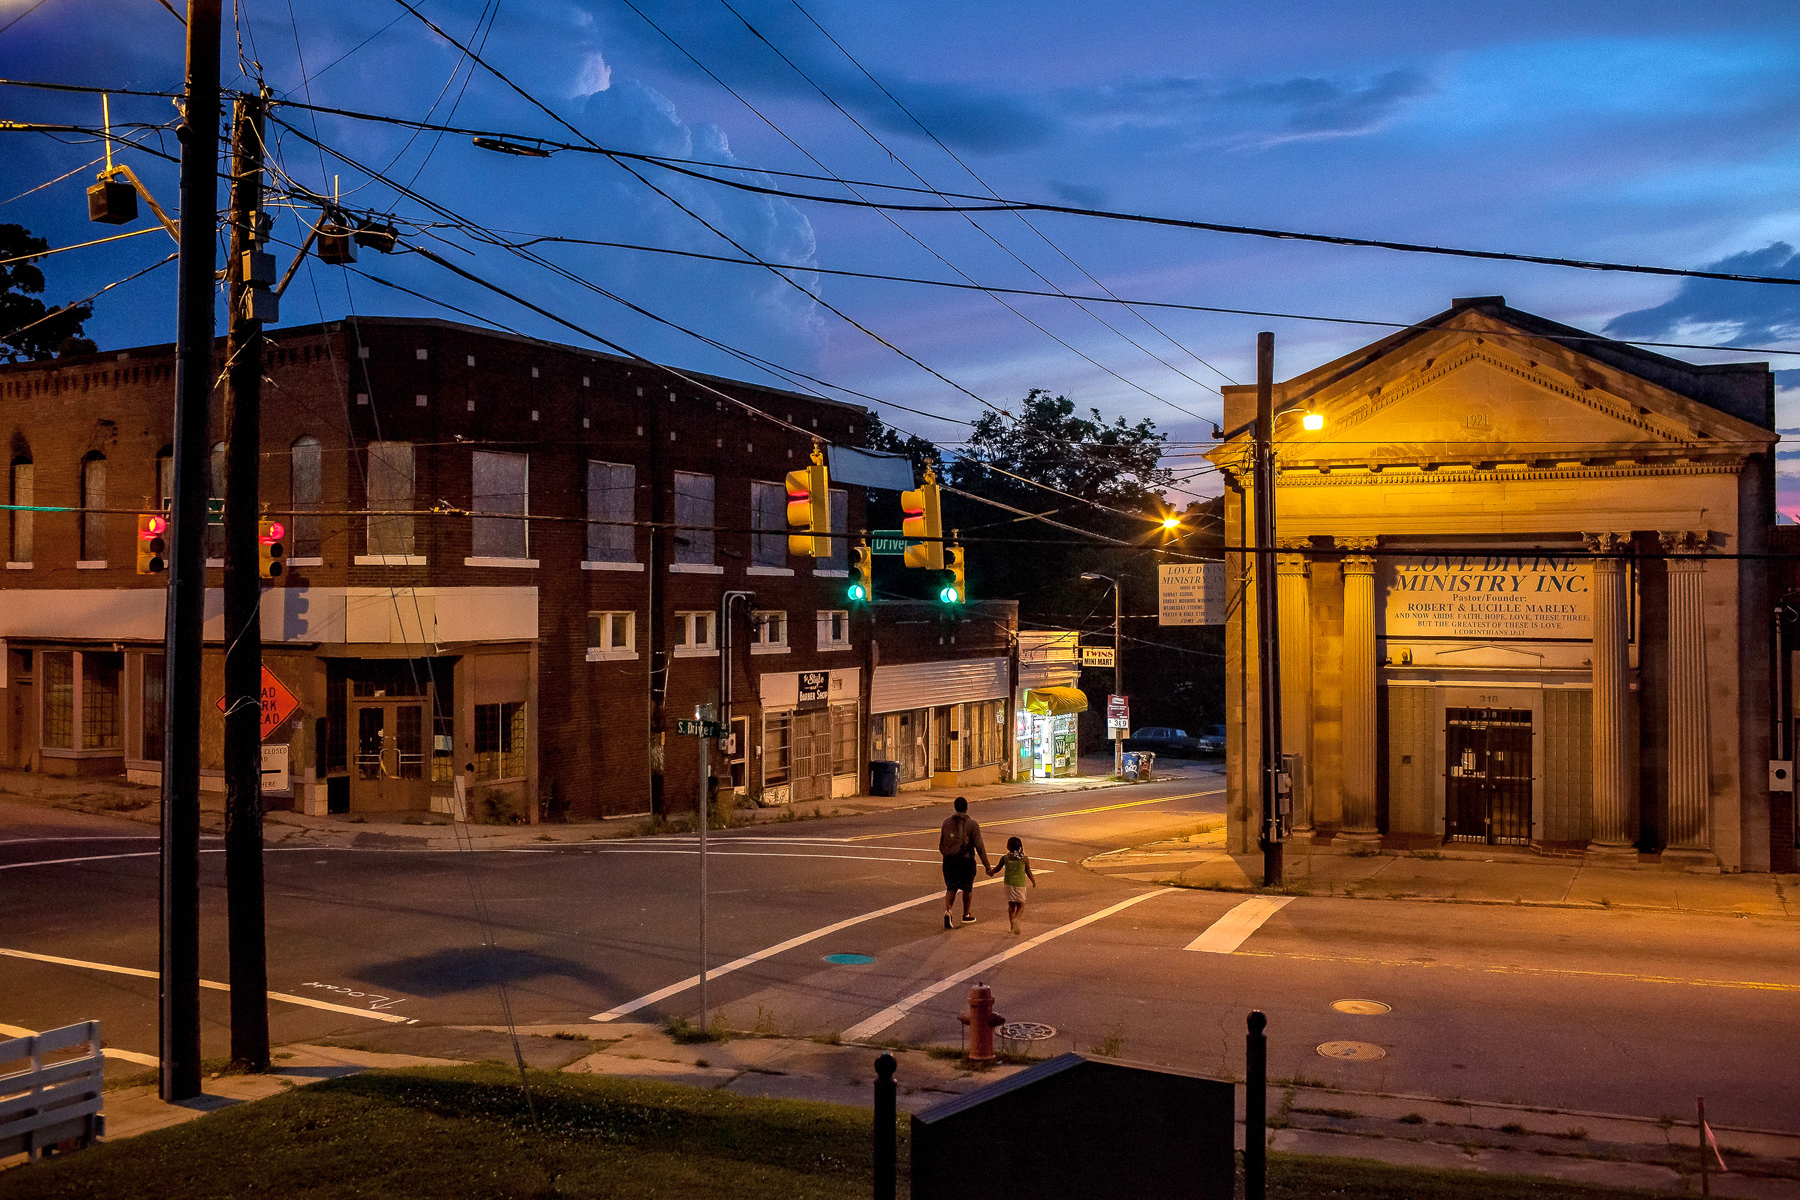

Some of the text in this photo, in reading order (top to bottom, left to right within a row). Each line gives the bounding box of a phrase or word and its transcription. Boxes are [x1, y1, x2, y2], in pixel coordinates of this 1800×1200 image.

[1465, 413, 1488, 427] 1921
[1404, 556, 1577, 573] LOVE DIVINE
[1168, 566, 1192, 575] LOVE
[1395, 574, 1588, 593] MINISTRY INC.
[1453, 593, 1527, 603] Pastor/Founder:
[1407, 603, 1578, 614] ROBERT & LUCILLE MARLEY
[1412, 612, 1429, 620] NOW
[1432, 612, 1454, 620] ABIDE
[1457, 612, 1483, 621] FAITH,
[1484, 613, 1508, 621] HOPE,
[1509, 613, 1533, 621] LOVE,
[1534, 613, 1559, 621] THESE
[1434, 620, 1449, 628] THE
[1504, 621, 1529, 629] THESE
[1097, 658, 1113, 666] MART
[807, 673, 825, 687] Style
[261, 687, 276, 698] AD
[1479, 695, 1499, 703] 318
[261, 700, 277, 711] RK
[260, 713, 280, 724] EAD
[1482, 711, 1497, 719] 38
[678, 721, 685, 734] S.
[687, 721, 714, 736] Driver
